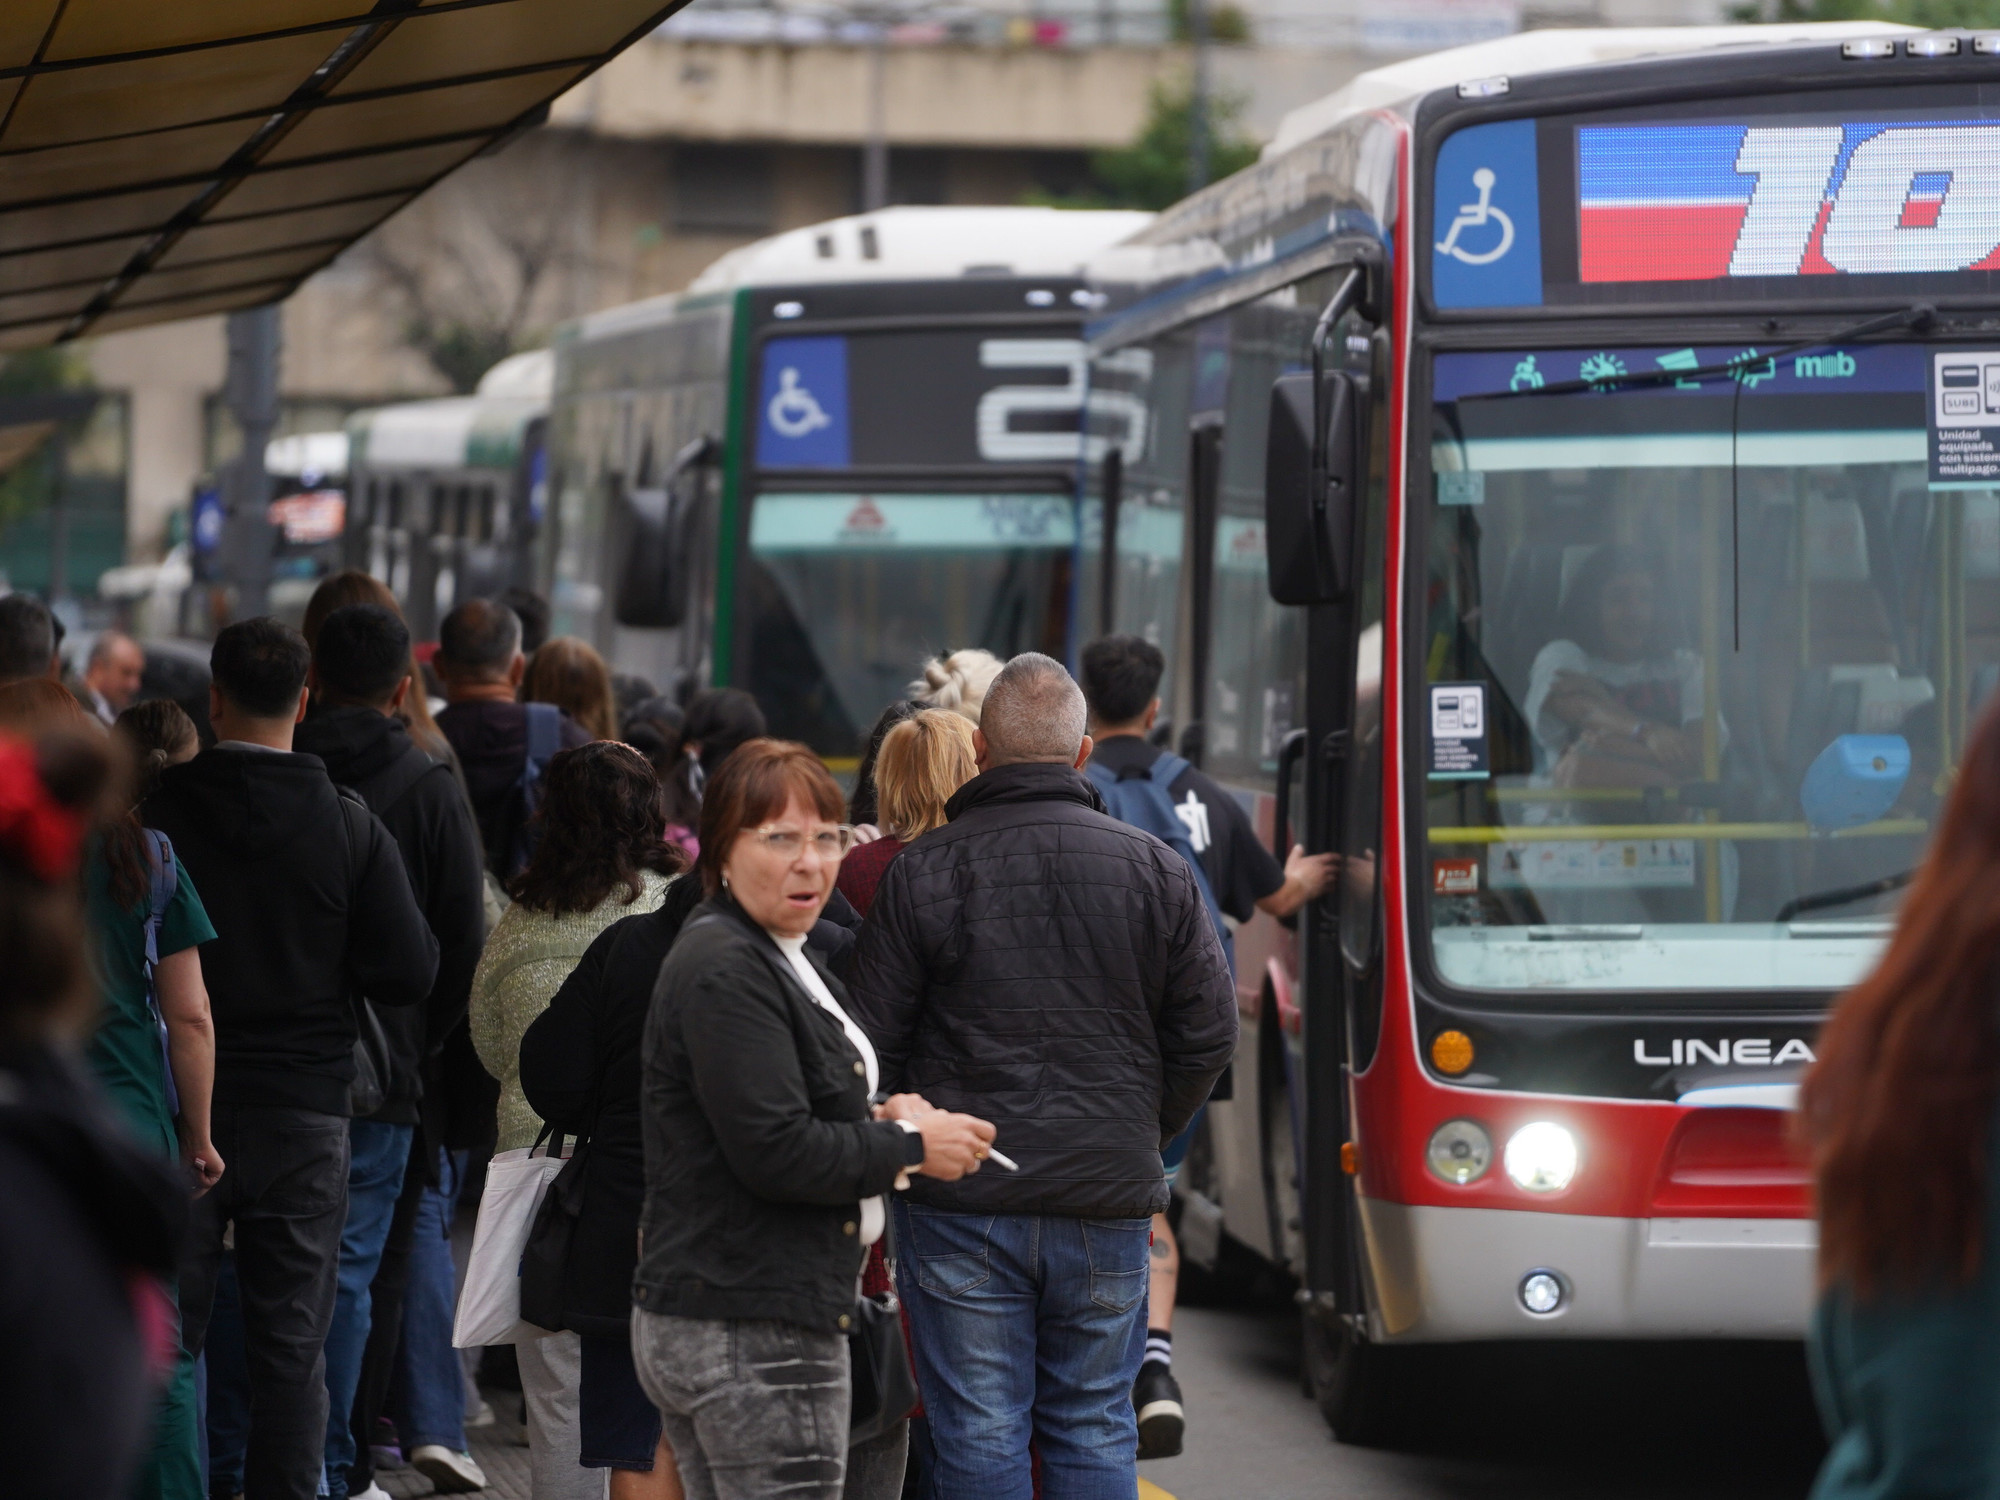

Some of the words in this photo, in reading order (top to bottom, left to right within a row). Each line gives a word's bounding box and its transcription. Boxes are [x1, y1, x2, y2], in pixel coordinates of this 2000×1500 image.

[1946, 398, 1976, 409] SUBE
[1938, 429, 1981, 441] Unidad
[1938, 441, 1994, 454] equipada
[1938, 453, 1962, 463] con
[1963, 451, 2000, 463] sistem
[1634, 1038, 1818, 1066] LINEA
